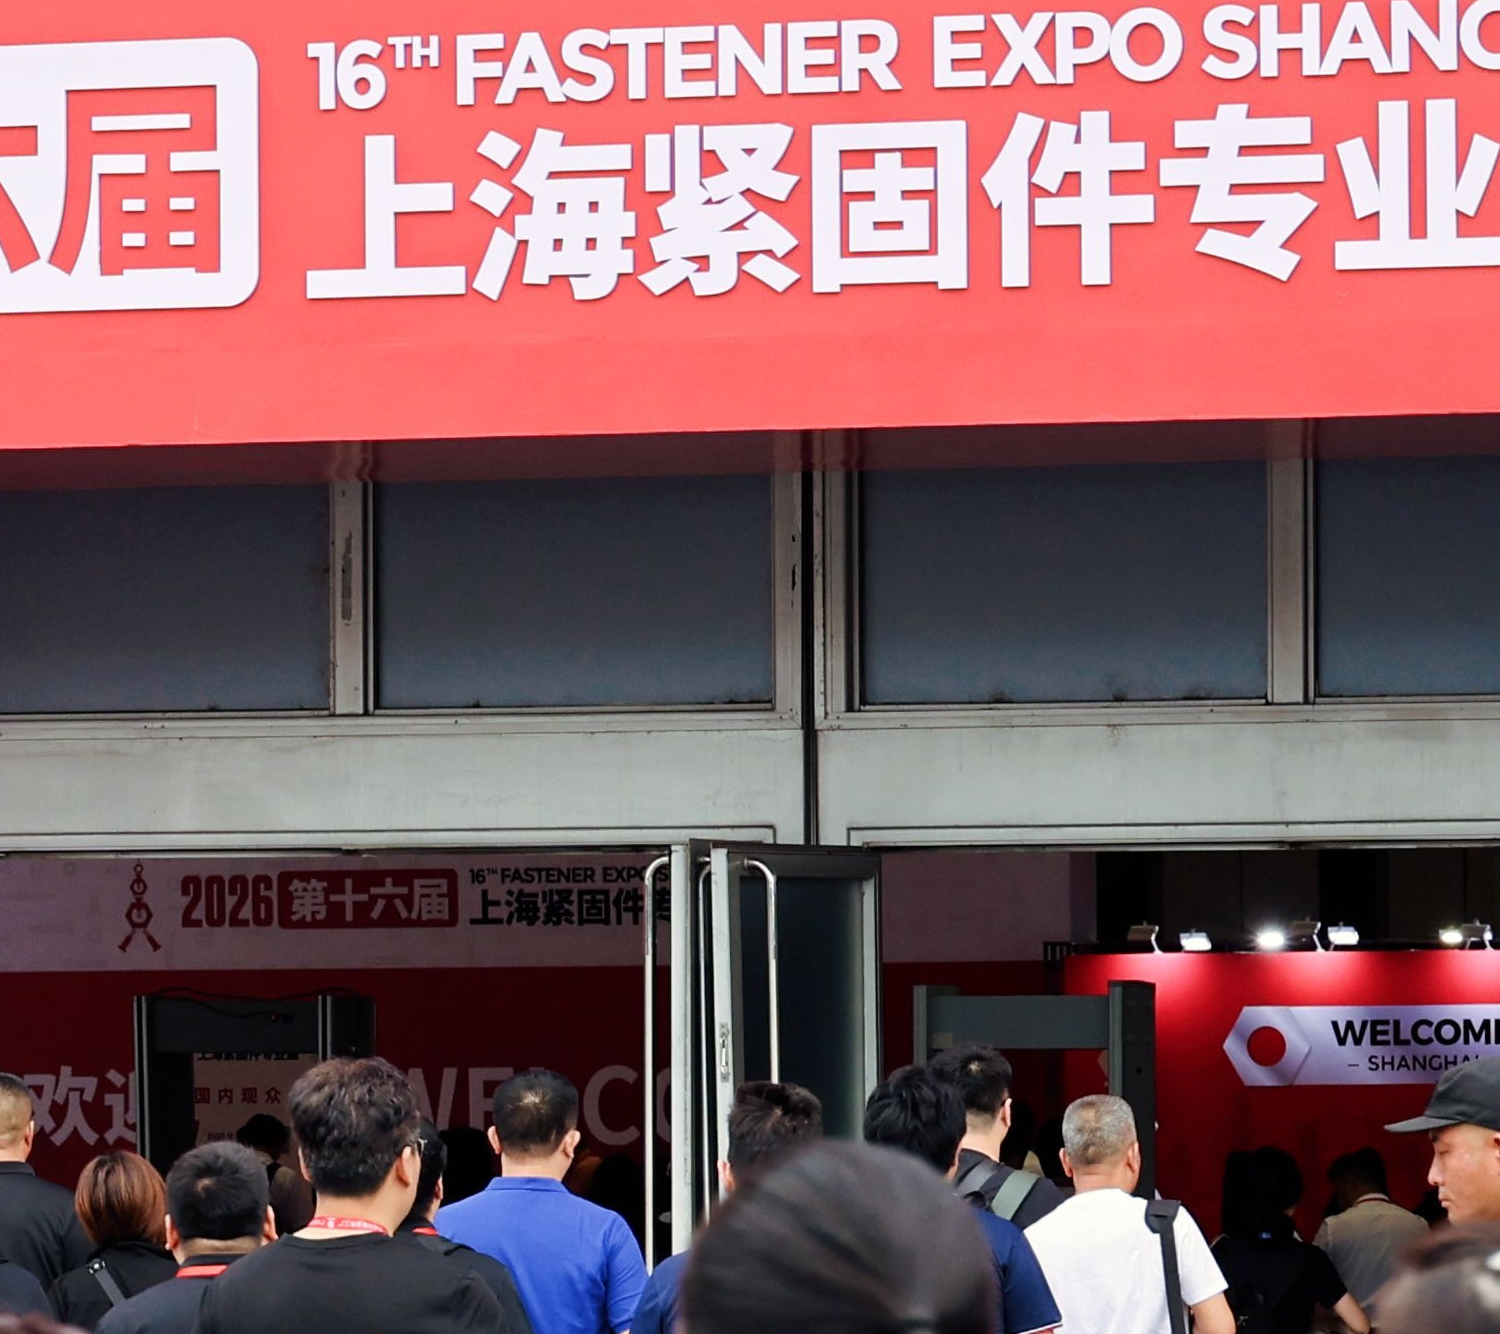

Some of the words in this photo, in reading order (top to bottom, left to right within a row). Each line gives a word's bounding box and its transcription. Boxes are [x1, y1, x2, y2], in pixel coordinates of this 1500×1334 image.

[457, 20, 901, 105] FASTENER
[934, 7, 1183, 87] EXPO
[501, 866, 596, 884] FASTENER
[181, 874, 273, 928] 2026
[288, 877, 450, 923] 第十六届
[1368, 1054, 1479, 1071] SHANGHA
